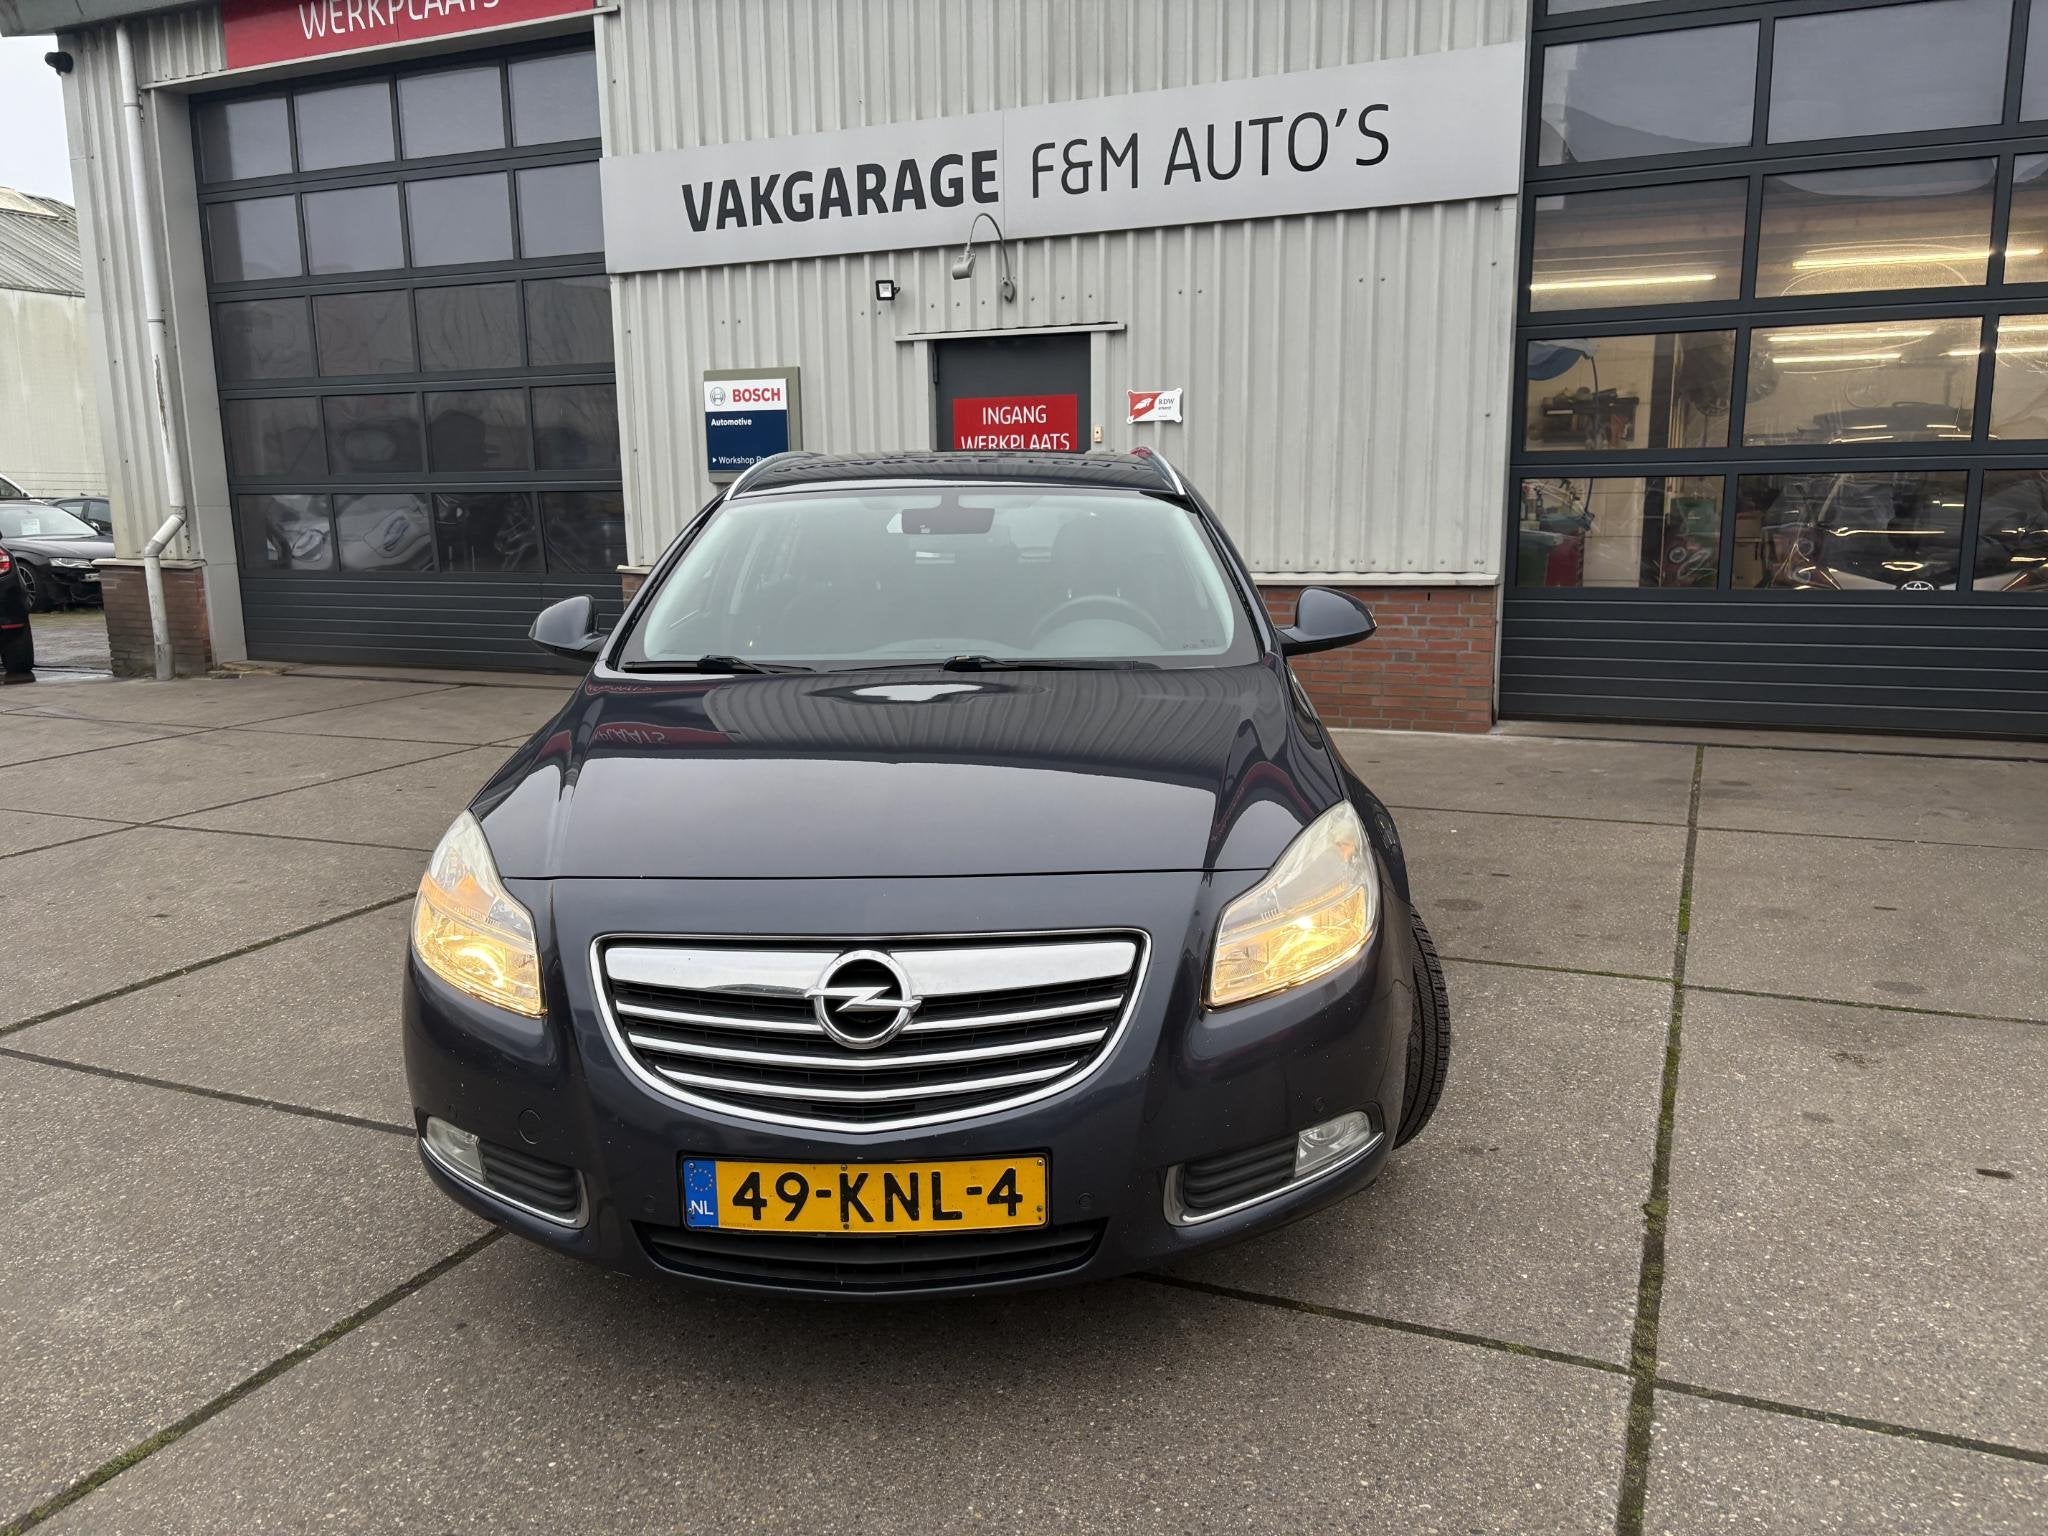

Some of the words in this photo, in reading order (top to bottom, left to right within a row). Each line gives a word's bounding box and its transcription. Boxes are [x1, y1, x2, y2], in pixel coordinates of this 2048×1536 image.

[300, 0, 499, 40] WERKPLA
[681, 149, 999, 233] VAKGARAGE
[1032, 132, 1138, 199] F&M
[1164, 103, 1390, 186] AUTO'S
[732, 387, 781, 403] BOSCH
[711, 418, 753, 427] Automotive
[982, 405, 1047, 425] INGANG
[718, 456, 755, 466] Workshop
[732, 1167, 1024, 1223] 49-KNL-4
[691, 1200, 714, 1215] NL
